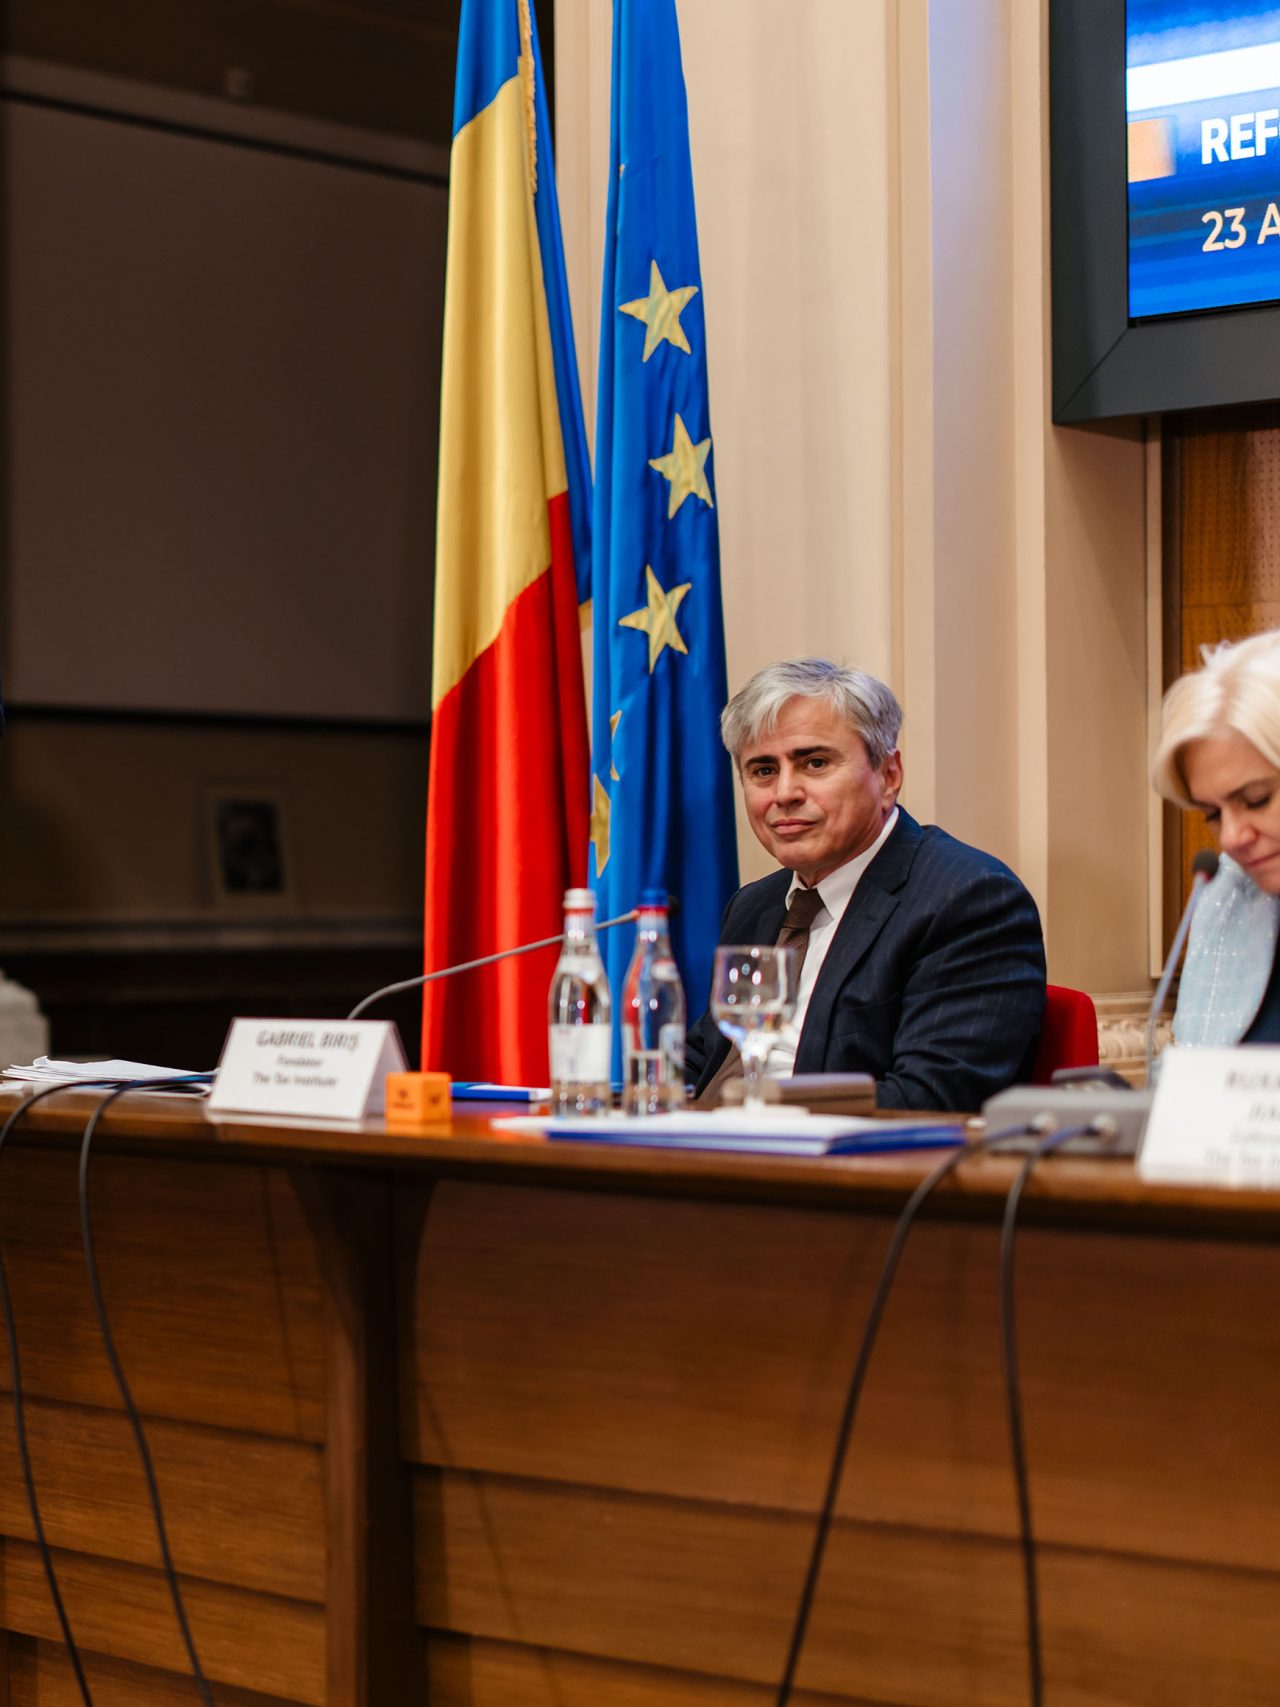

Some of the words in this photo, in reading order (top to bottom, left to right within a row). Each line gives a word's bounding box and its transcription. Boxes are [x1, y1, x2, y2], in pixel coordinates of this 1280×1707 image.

[1201, 109, 1280, 165] REF
[1202, 207, 1247, 252] 23
[256, 1030, 315, 1048] GABRIEL
